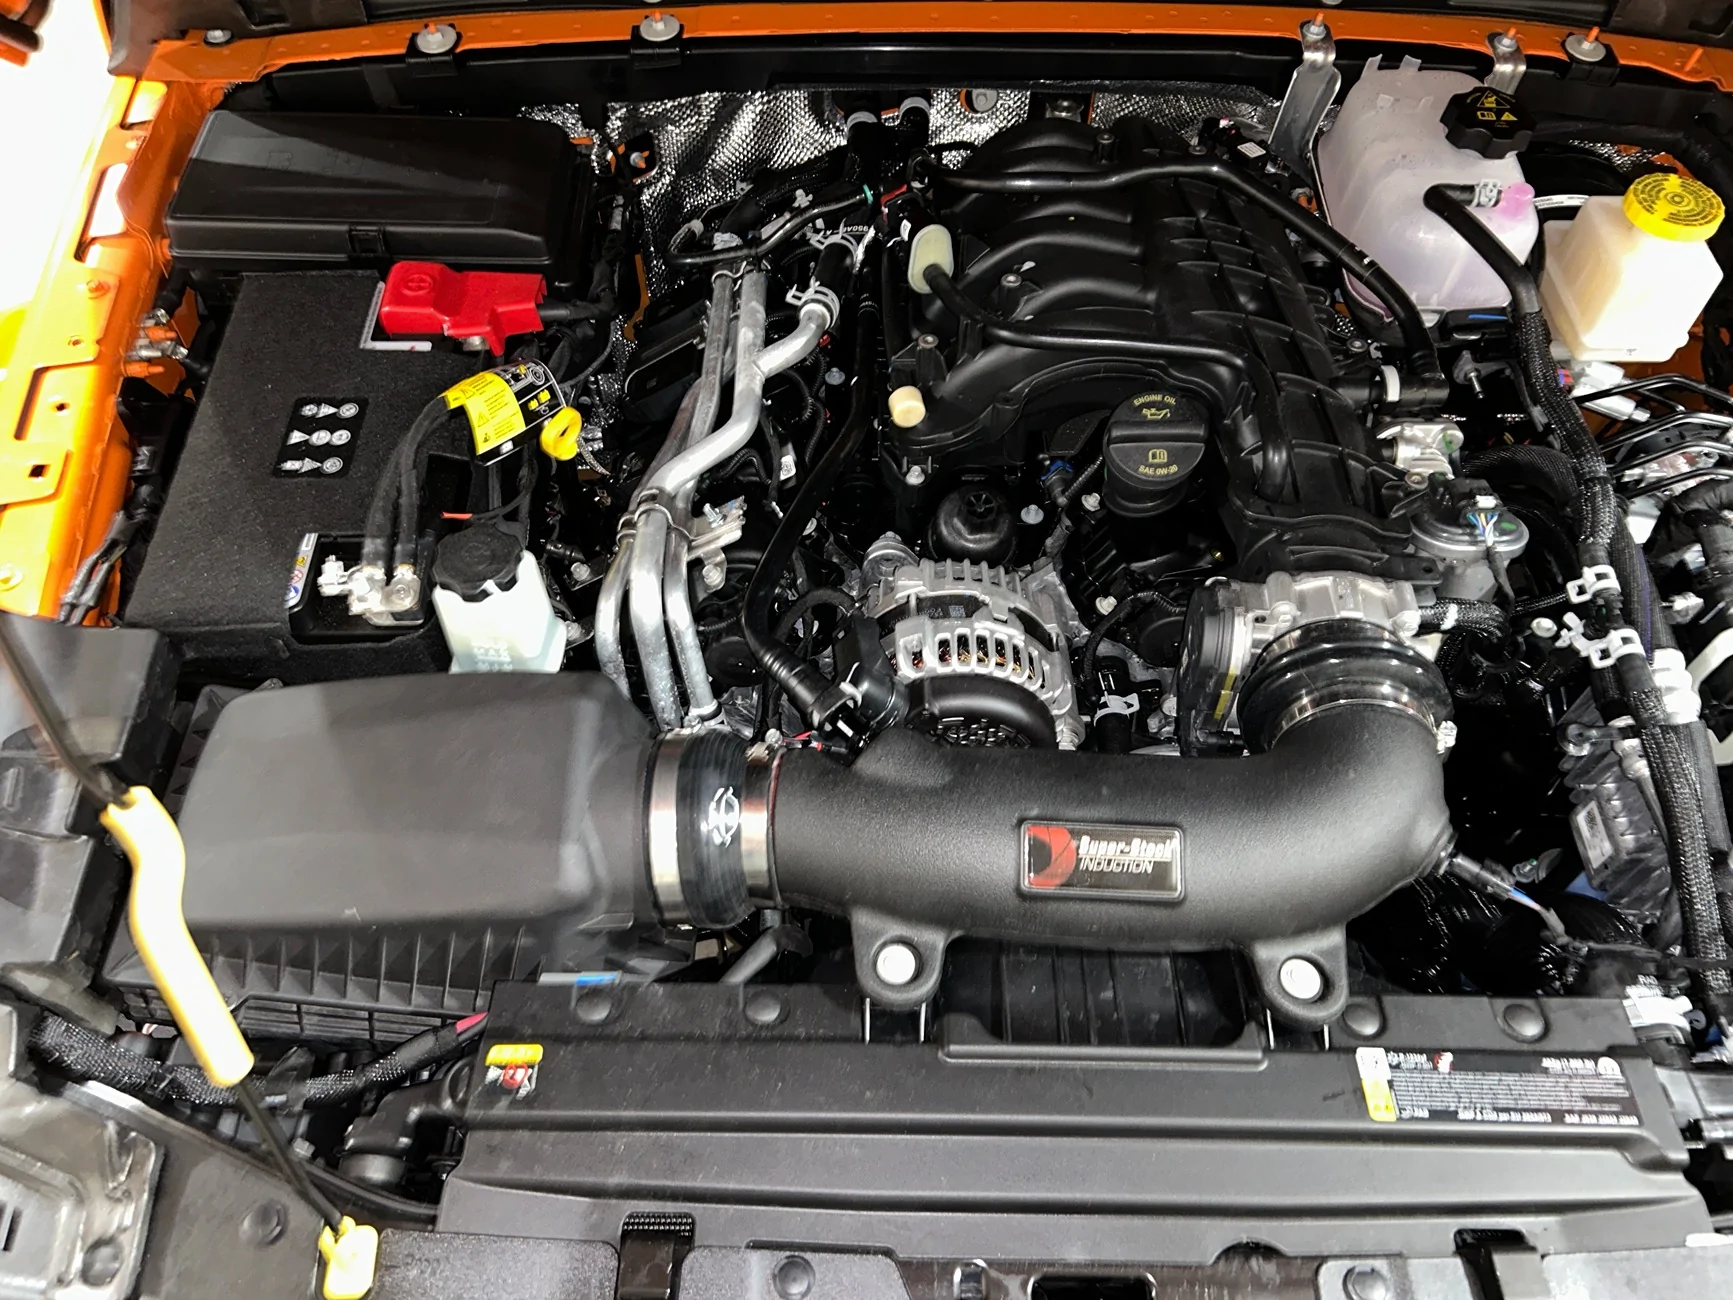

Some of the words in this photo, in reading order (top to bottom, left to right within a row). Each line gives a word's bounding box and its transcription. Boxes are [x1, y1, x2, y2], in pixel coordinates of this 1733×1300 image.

[1133, 394, 1163, 406] ENGINE
[1164, 395, 1177, 405] OIL
[1139, 465, 1155, 475] SAE
[1156, 464, 1178, 475] 0W-20
[1078, 835, 1177, 859] Super-Stock
[1079, 857, 1154, 874] INDUCTION
